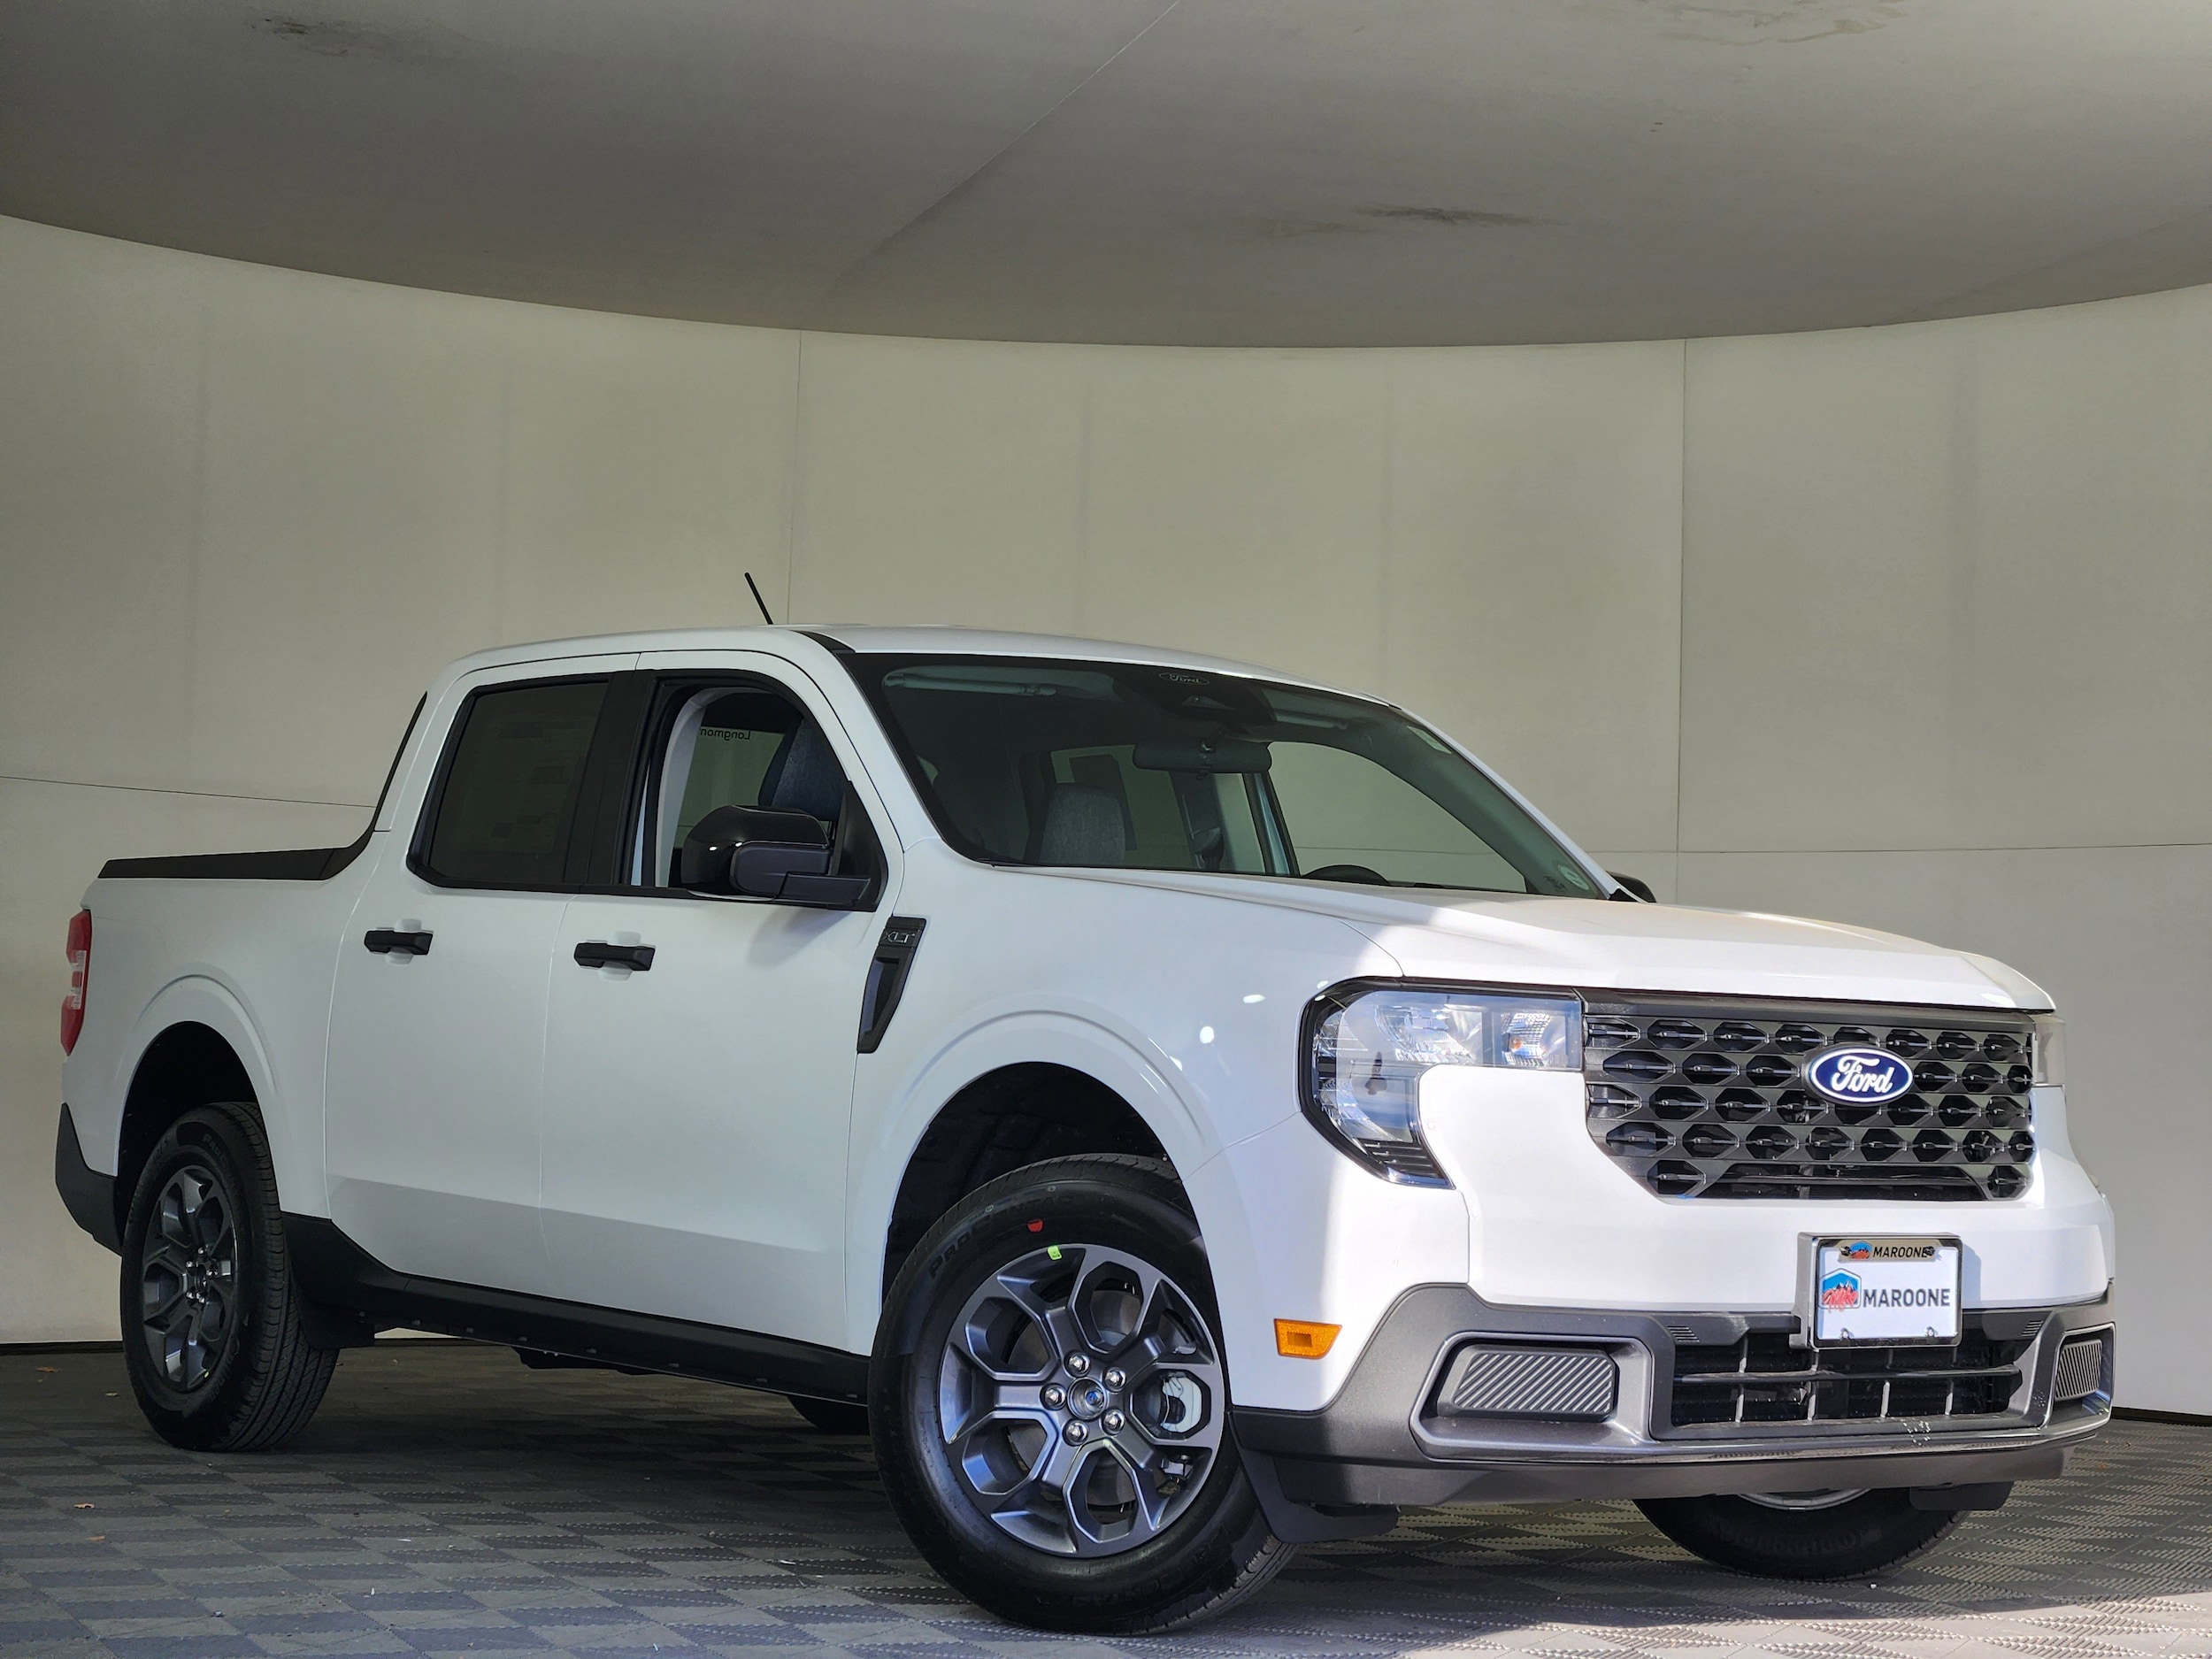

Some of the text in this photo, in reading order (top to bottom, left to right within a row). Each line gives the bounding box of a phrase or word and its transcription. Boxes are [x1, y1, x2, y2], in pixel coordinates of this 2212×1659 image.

[1169, 673, 1202, 684] Ford
[880, 929, 915, 943] XLT
[1831, 1053, 1894, 1094] Ford
[1872, 1246, 1928, 1258] MAROONE
[1863, 1288, 1950, 1307] MAROONE
